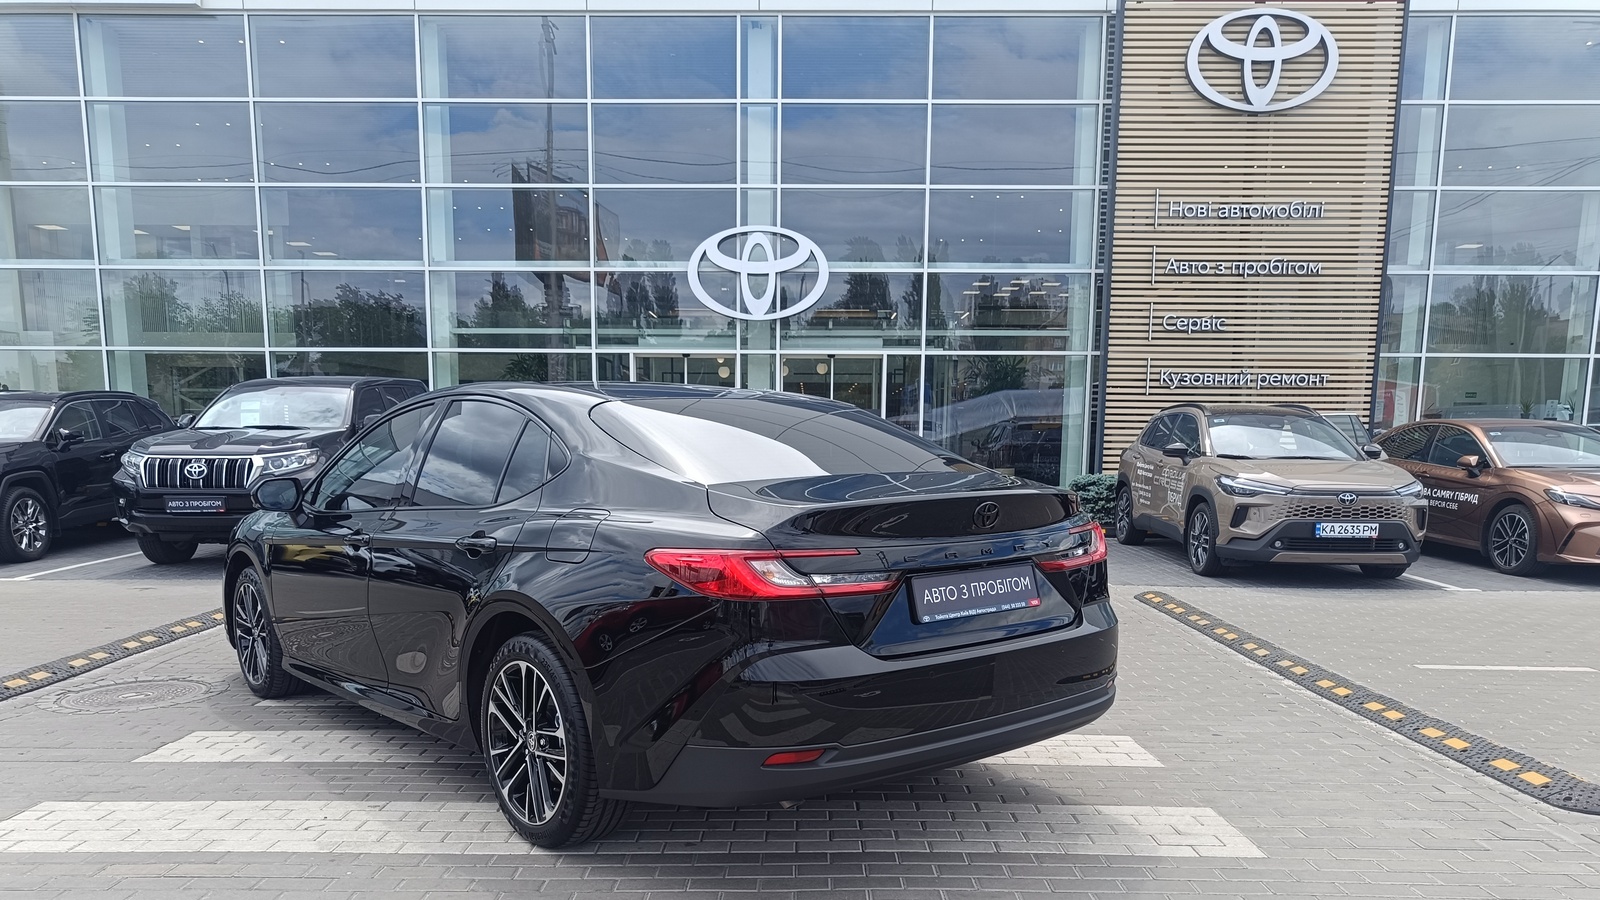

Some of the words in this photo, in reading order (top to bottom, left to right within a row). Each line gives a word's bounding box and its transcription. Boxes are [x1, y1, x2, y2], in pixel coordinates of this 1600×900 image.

[1168, 201, 1212, 218] Нові
[1218, 200, 1325, 218] автомобілі
[1164, 258, 1210, 275] Авто
[1215, 261, 1225, 274] з
[1231, 257, 1322, 279] пробігом
[1162, 314, 1227, 335] Сервіс
[1159, 368, 1251, 390] Кузовний
[1256, 373, 1330, 390] ремонт
[1153, 475, 1184, 491] CROSS
[1429, 499, 1446, 508] ВЕРСІЯ
[1432, 489, 1455, 500] CAMRY
[1454, 491, 1479, 505] ГІБРИД
[1321, 525, 1336, 534] KA
[1337, 525, 1361, 534] 2635
[1362, 525, 1377, 535] PM
[923, 585, 958, 604] АВТО
[960, 584, 969, 599] З
[970, 576, 1031, 597] ПРОБІГОМ
